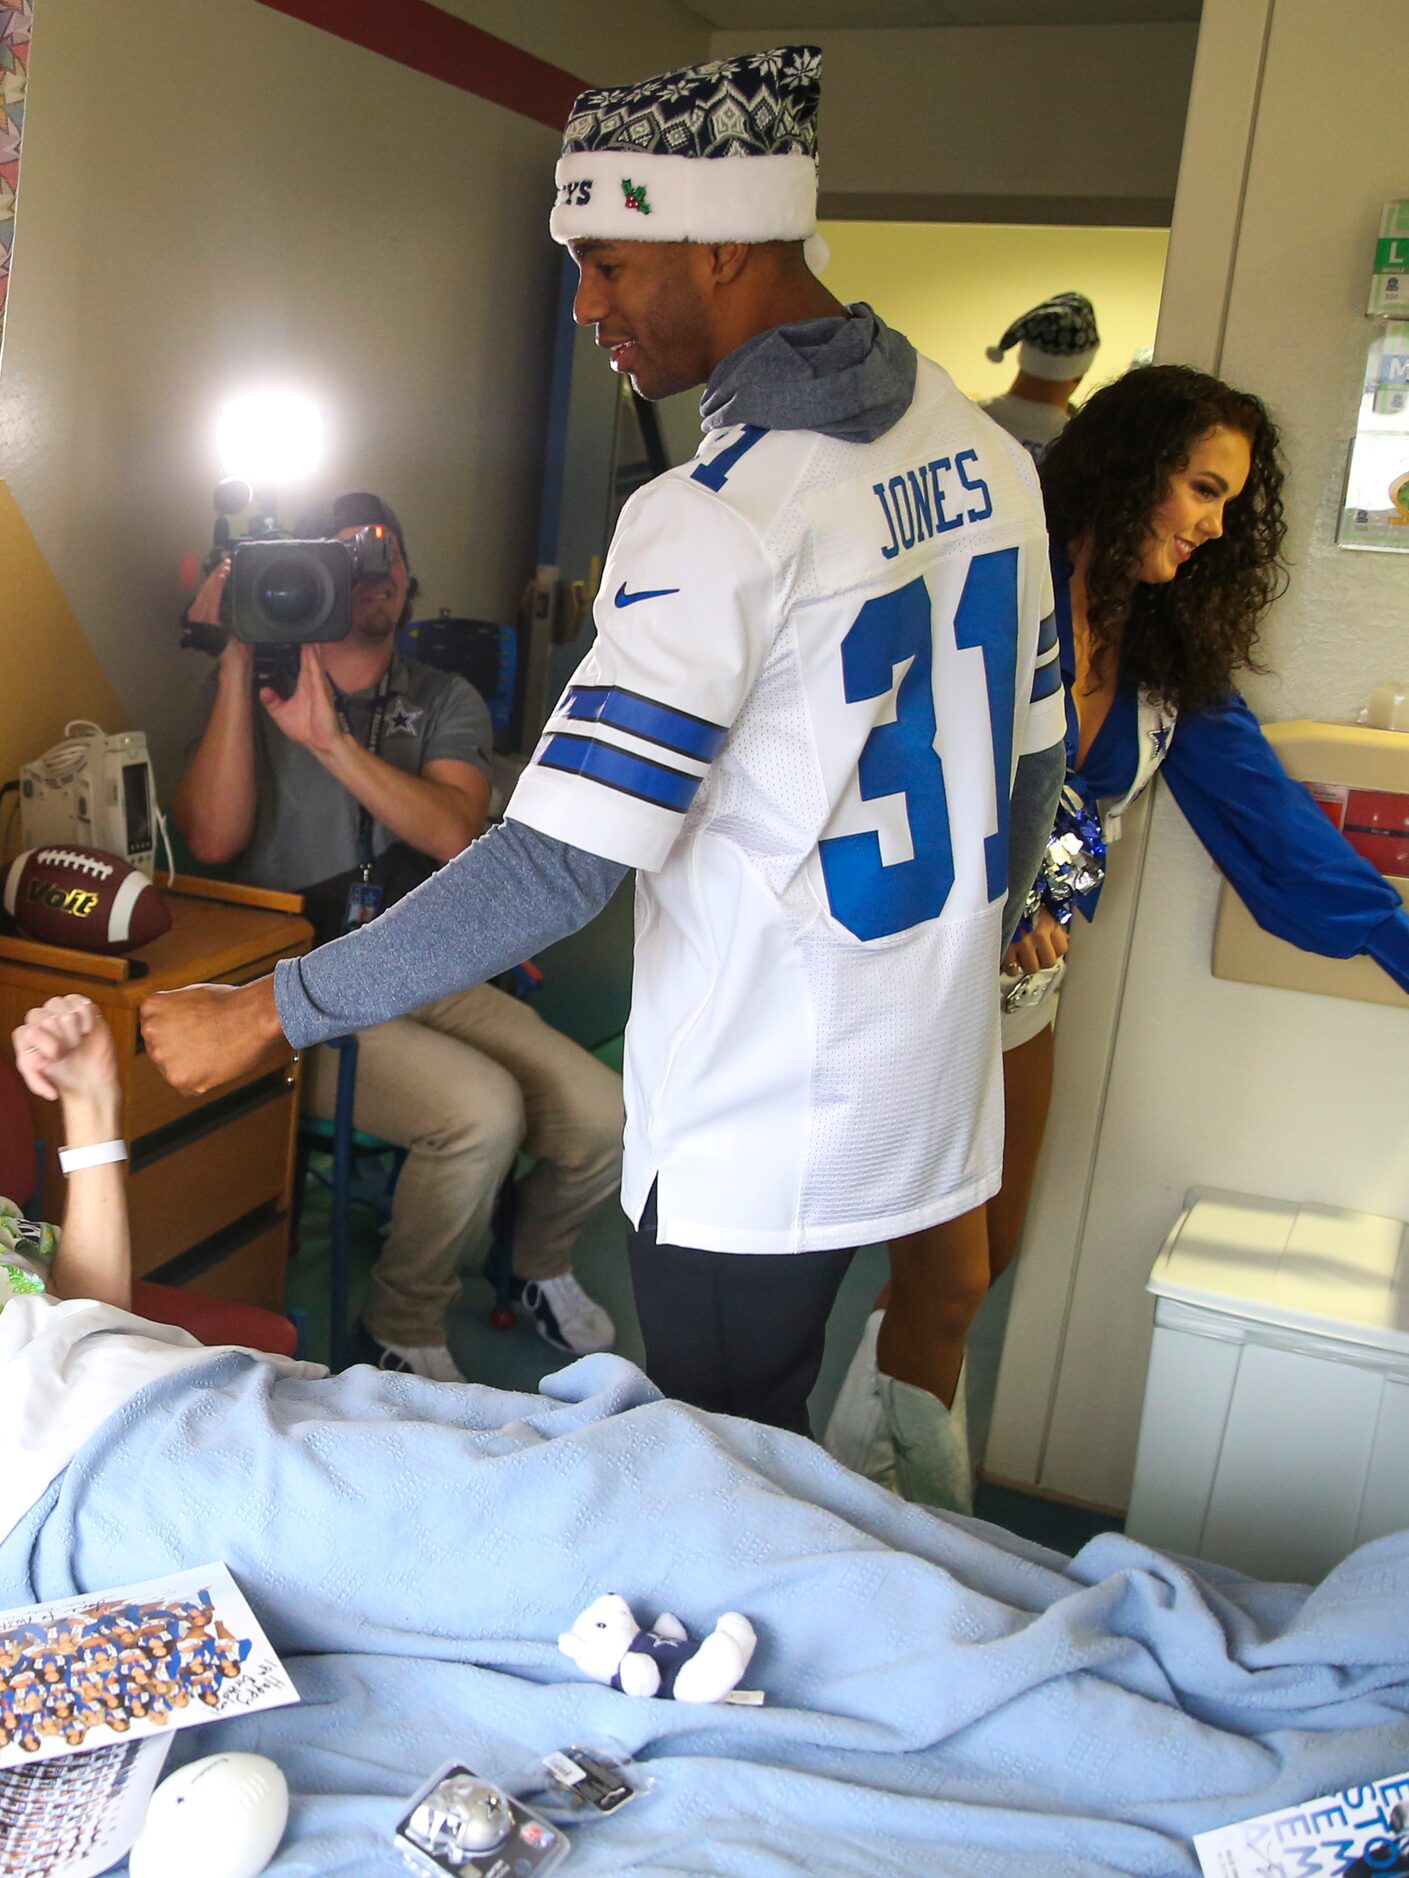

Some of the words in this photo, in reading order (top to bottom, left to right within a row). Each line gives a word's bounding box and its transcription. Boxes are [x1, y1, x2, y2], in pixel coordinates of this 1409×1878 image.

[563, 179, 593, 206] YS
[1388, 241, 1404, 264] L
[872, 448, 994, 560] JONES
[818, 546, 1020, 942] 31
[27, 878, 99, 918] Voit
